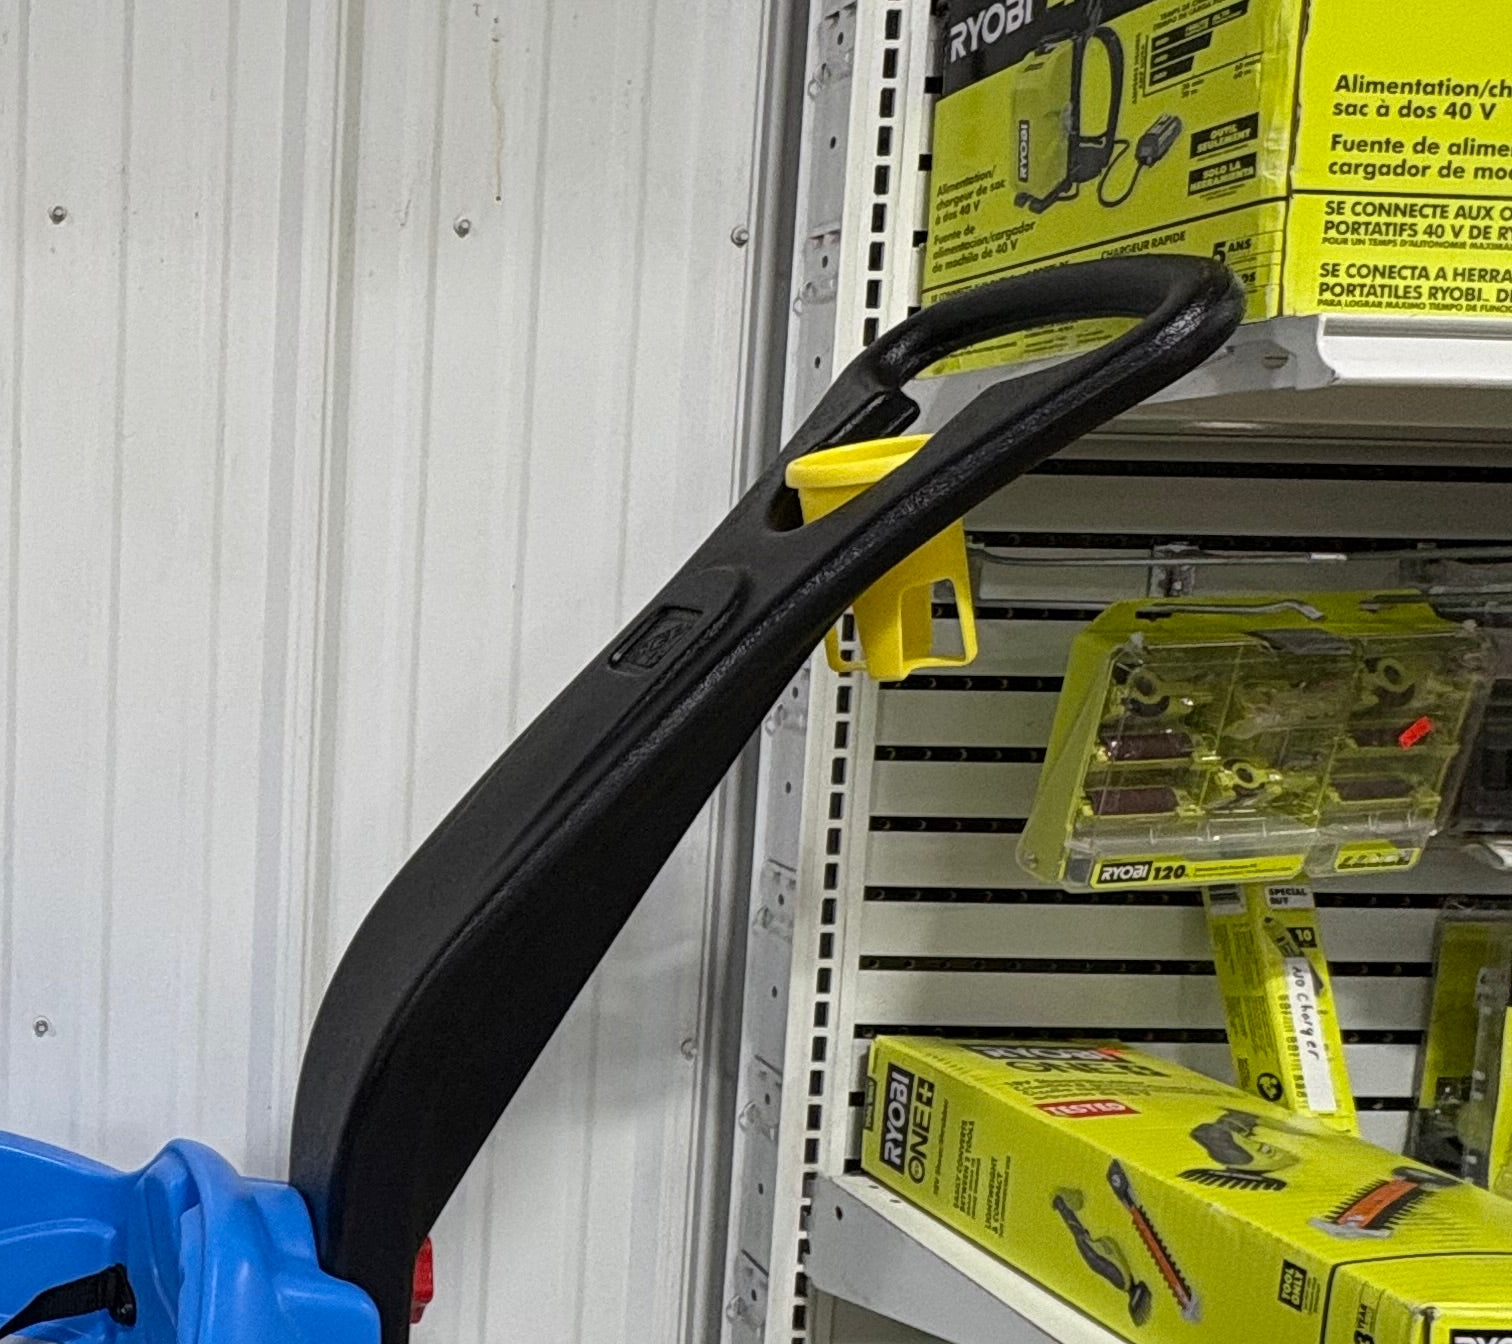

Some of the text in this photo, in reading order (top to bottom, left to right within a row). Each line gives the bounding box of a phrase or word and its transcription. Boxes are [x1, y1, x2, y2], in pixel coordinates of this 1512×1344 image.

[1332, 99, 1496, 121] sac à dos 40 V
[1020, 123, 1028, 179] RYOBI
[1330, 133, 1512, 157] Fuente de alime
[1328, 159, 1431, 180] cargador
[1438, 160, 1465, 180] de
[1324, 200, 1494, 221] SE CONNECTE AUX
[1151, 231, 1186, 248] RAPIDE
[1323, 220, 1493, 240] PORTATIFS 40 V DE
[1212, 238, 1252, 263] 5 ANS
[1322, 237, 1348, 246] POUR
[1351, 238, 1366, 247] UN
[1368, 238, 1398, 248] TEMPS
[1320, 263, 1341, 278] SE
[1345, 263, 1430, 281] CONECTA
[1433, 267, 1448, 282] A
[1317, 298, 1342, 307] PARA
[1344, 299, 1383, 309] LOGRAR
[1429, 302, 1463, 312] TIEMPO
[1465, 304, 1477, 312] DE
[1101, 864, 1148, 881] RYOBI
[1152, 865, 1186, 881] 120
[1269, 888, 1307, 896] SPECIAL
[884, 1071, 910, 1166] RYOBI
[1281, 1268, 1294, 1300] TOOL
[1291, 1270, 1304, 1305] ONLY
